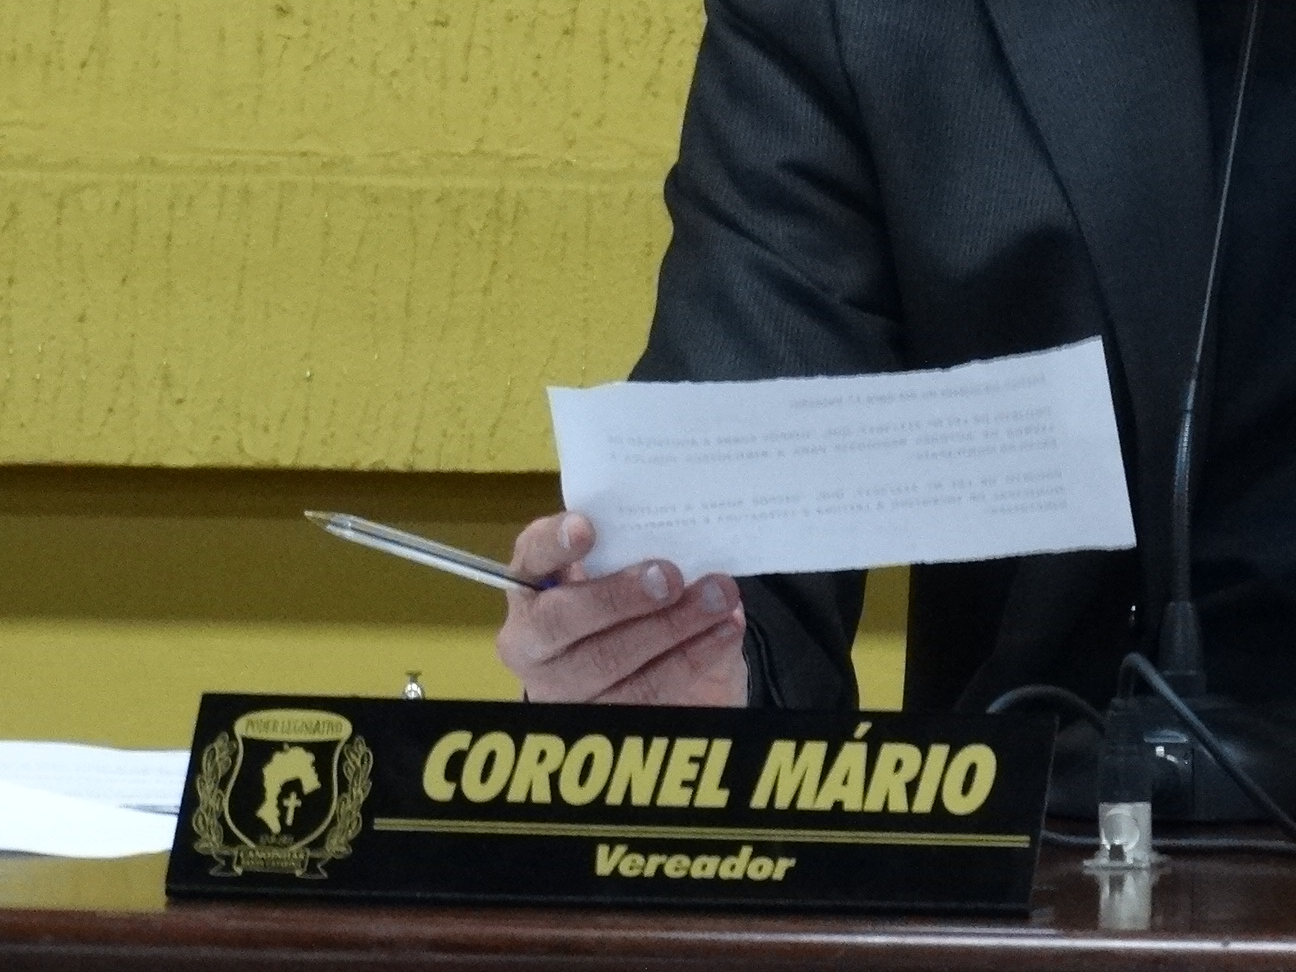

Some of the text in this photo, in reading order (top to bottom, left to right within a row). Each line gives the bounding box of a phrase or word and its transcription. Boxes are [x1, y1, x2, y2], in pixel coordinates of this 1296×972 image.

[245, 718, 278, 735] PODER
[422, 721, 997, 816] CORONEL MÁRIO
[595, 844, 796, 881] Vereador
